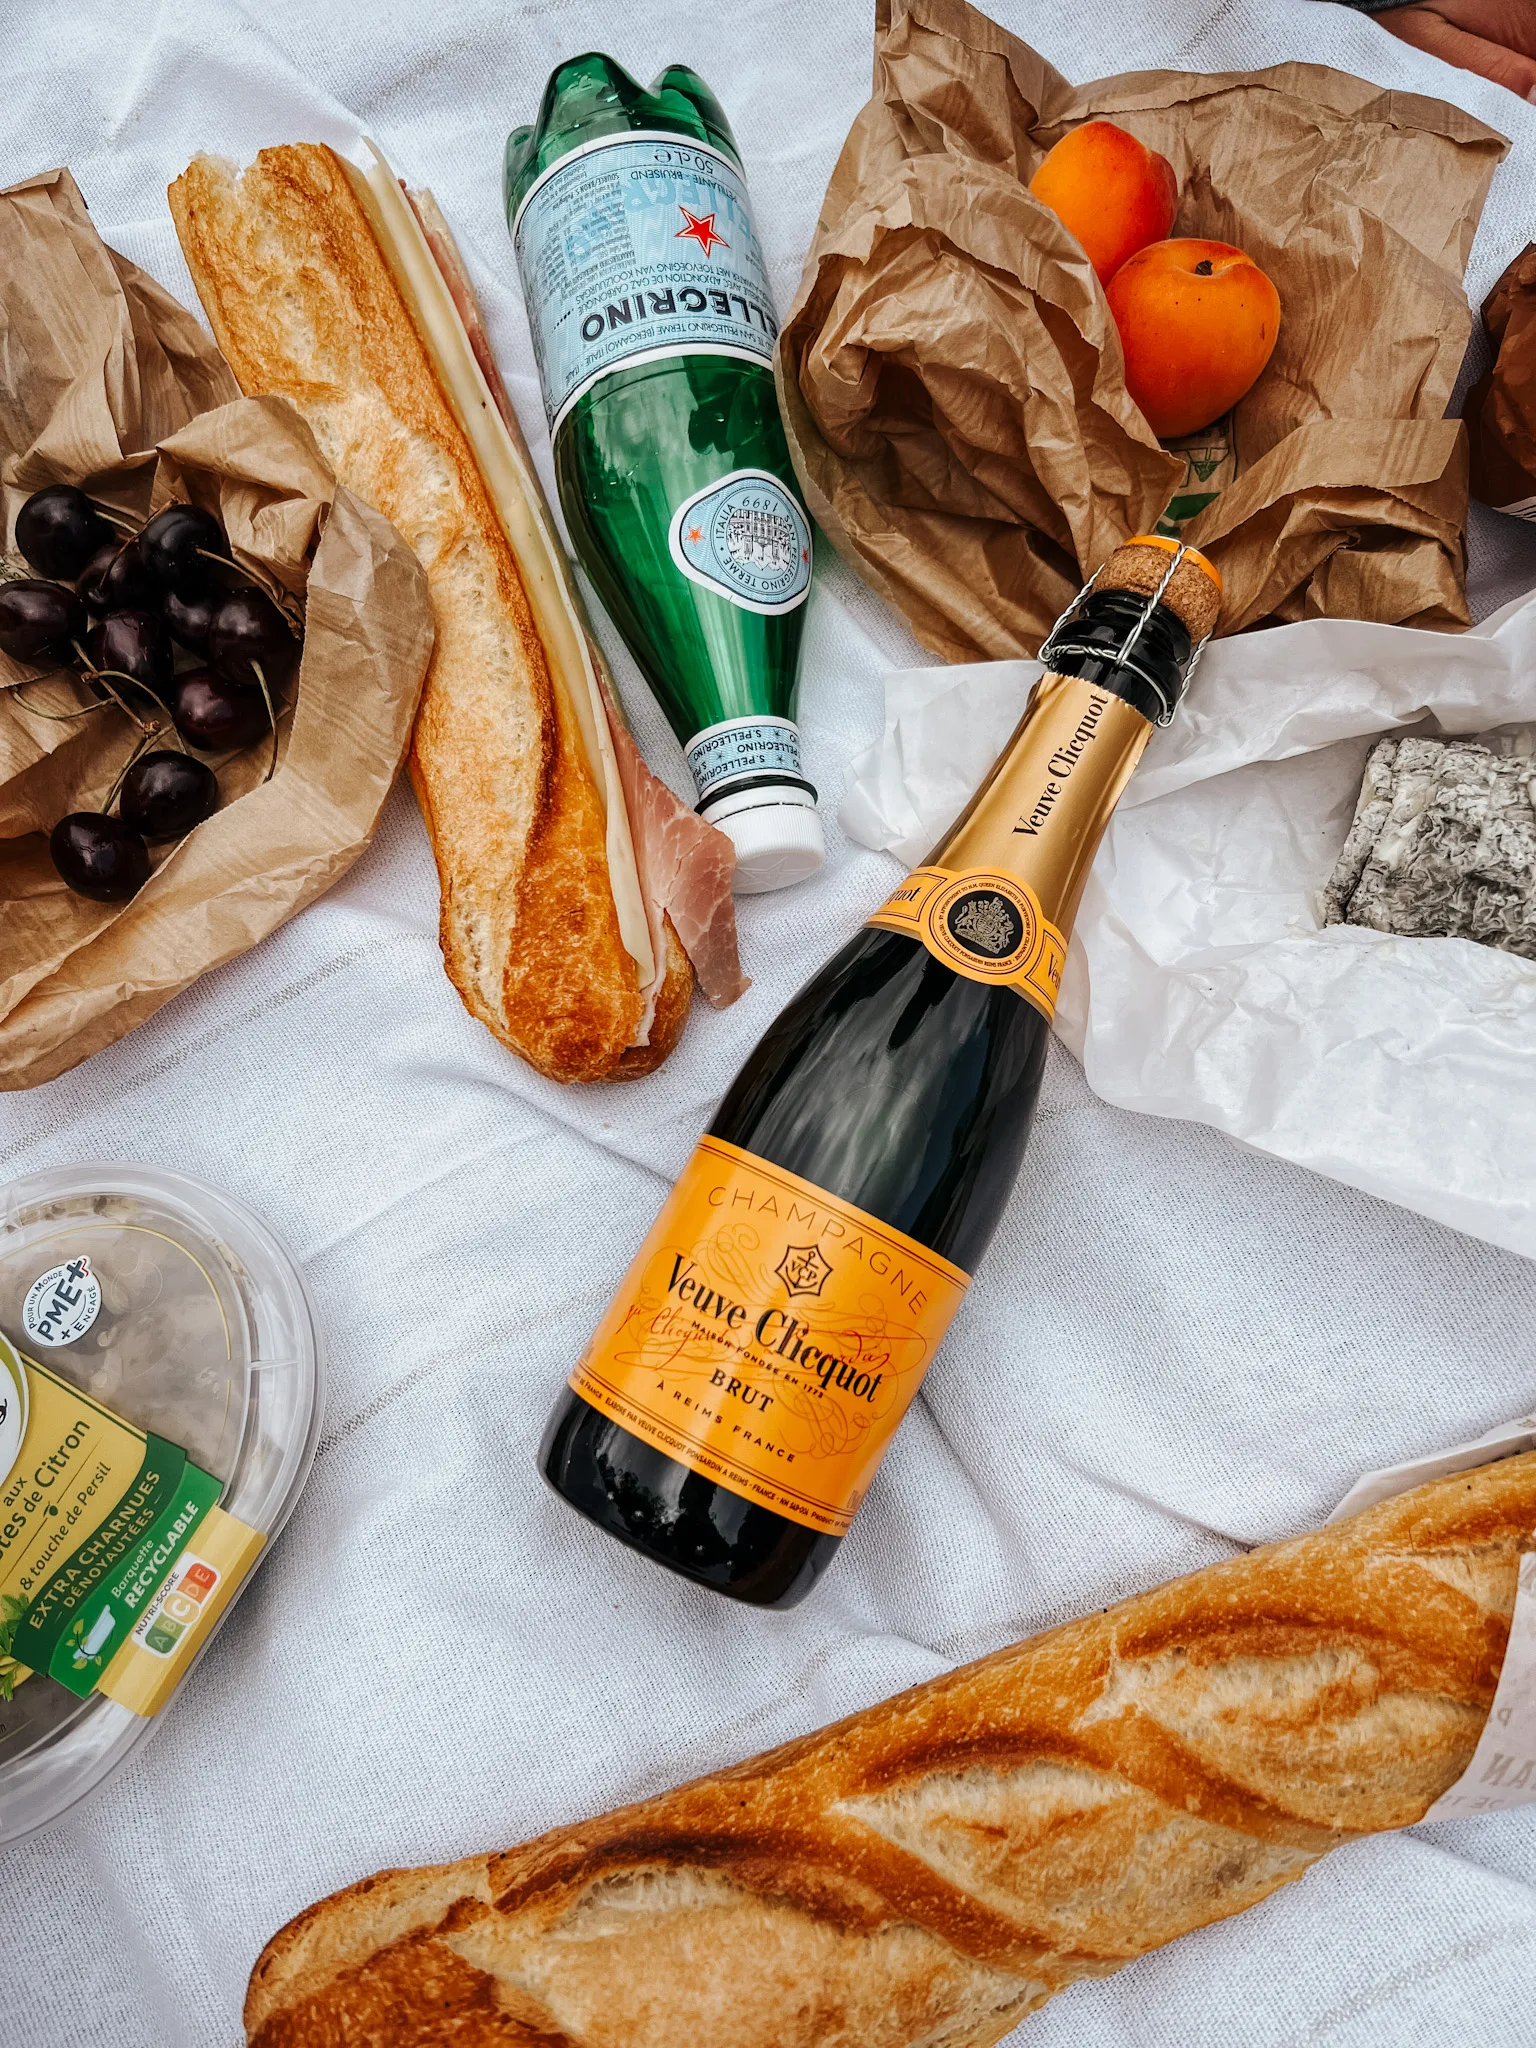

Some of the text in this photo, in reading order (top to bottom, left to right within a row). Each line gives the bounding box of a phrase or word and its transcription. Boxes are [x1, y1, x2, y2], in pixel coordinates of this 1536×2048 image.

[631, 170, 683, 180] BRUISEND
[695, 157, 713, 174] 50
[630, 278, 650, 290] GAZ
[636, 265, 655, 277] VAN
[651, 275, 663, 284] DE
[657, 263, 714, 275] TOEVOEGING
[665, 274, 720, 285] ADJONCTION
[716, 267, 730, 277] MET
[576, 270, 634, 304] KOOLZUURGAS
[578, 284, 628, 316] CARBONIQUE
[724, 279, 741, 292] AVEC
[656, 324, 685, 336] TERME
[687, 323, 738, 336] PELLEGRINO
[740, 330, 757, 342] SAN
[574, 348, 594, 365] ITALIE
[742, 496, 779, 512] 1899
[716, 504, 797, 590] SAN PELLEGRINO TERME ITALIA
[693, 730, 761, 760] S.PELLEGRINO
[737, 741, 800, 757] .PELLEGRINO
[700, 755, 765, 785] S.PELLEGRINO
[1012, 693, 1109, 839] Veuve Clicquot
[995, 883, 1018, 900] ELIZABETH
[943, 935, 960, 953] CLICQUOT
[997, 959, 1012, 968] FRANCE
[708, 1186, 928, 1316] CHAMPAGNE
[28, 1270, 63, 1329] POUR UN MONDE
[74, 1285, 97, 1332] ENGAGÉ
[668, 1252, 746, 1330] Veuve
[755, 1307, 884, 1403] Clicquot
[691, 1320, 732, 1348] MAISON
[736, 1346, 780, 1376] FONDÉE
[784, 1372, 799, 1385] EN
[709, 1367, 774, 1413] BRUT
[584, 1381, 602, 1399] FRANCE
[626, 1411, 638, 1422] PAR
[638, 1417, 656, 1435] VEUVE
[656, 1430, 687, 1452] CLICQUOT
[686, 1448, 723, 1473] PONSARDIN
[728, 1472, 749, 1487] REIMS
[752, 1484, 775, 1500] FRANCE
[673, 1391, 723, 1424] REIMS
[733, 1424, 797, 1463] FRANCE
[24, 1491, 43, 1513] de
[34, 1420, 91, 1488] Citron
[4, 1476, 28, 1507] aux
[20, 1461, 112, 1591] & touche de Persil
[29, 1470, 160, 1630] EXTRA CHARNUES
[63, 1508, 155, 1608] DÉNOYAUTÉES
[124, 1500, 199, 1609] RECYCLABLE
[111, 1539, 154, 1599] Barquette
[135, 1571, 180, 1636] NUTRI-SCORE
[172, 1599, 191, 1618] C
